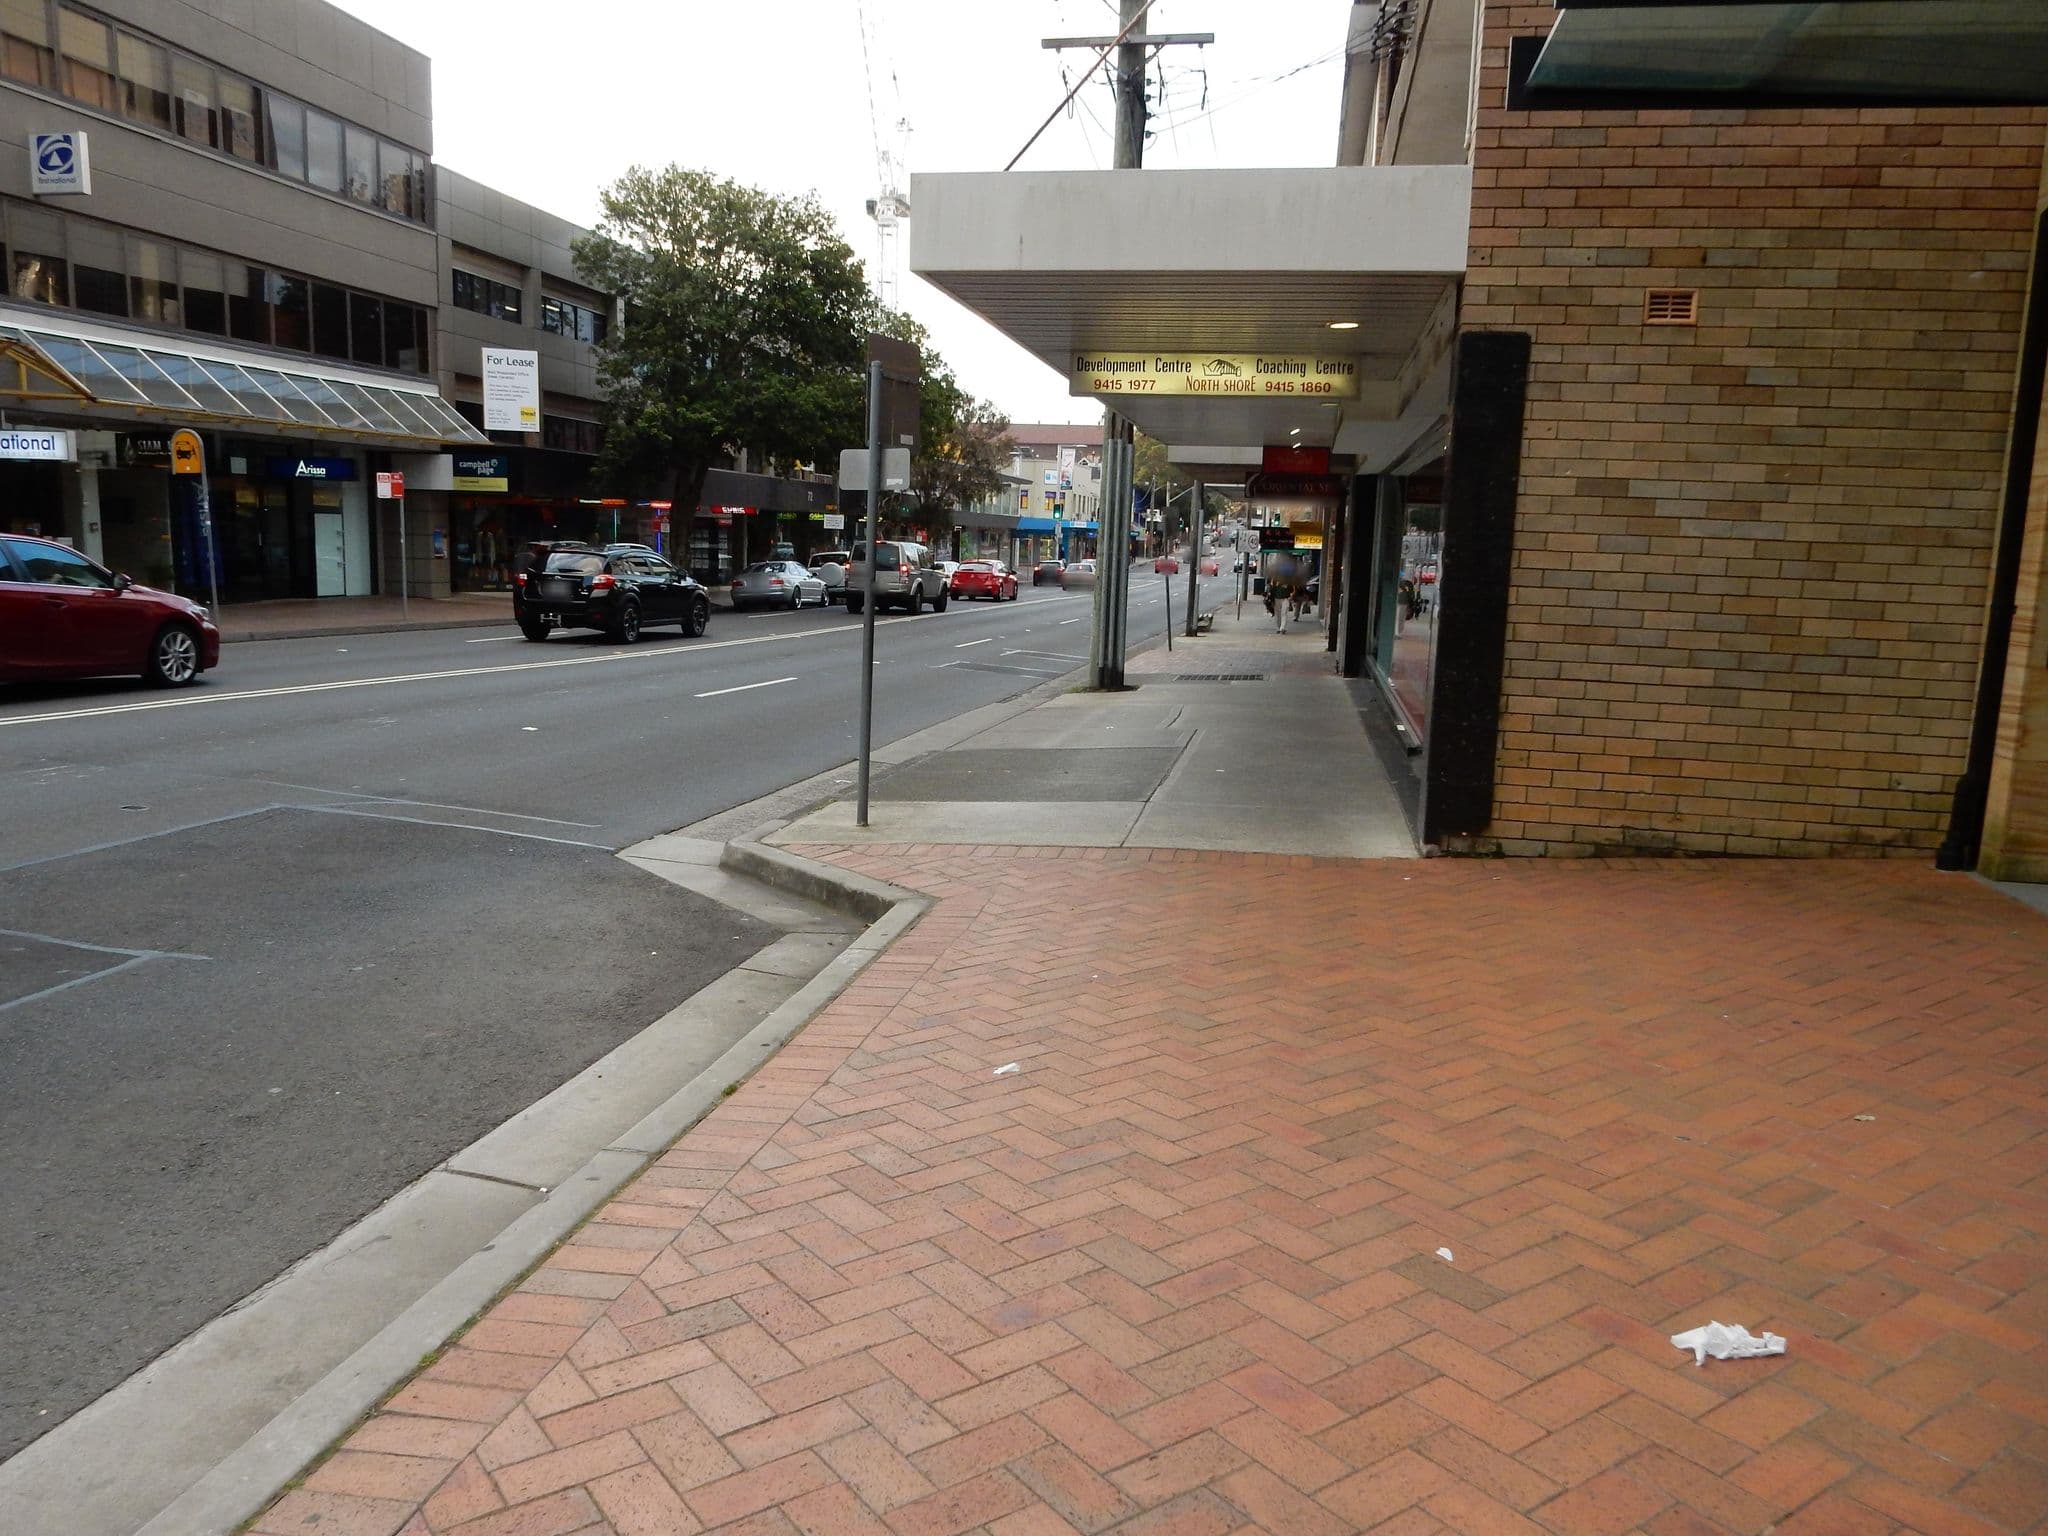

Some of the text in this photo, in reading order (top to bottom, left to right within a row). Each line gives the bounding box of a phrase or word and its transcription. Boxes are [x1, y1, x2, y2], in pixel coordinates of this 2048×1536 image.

[487, 355, 535, 367] For Lease
[1076, 356, 1192, 376] Development Centre
[1256, 358, 1354, 377] Coaching Centre
[1093, 379, 1157, 391] 9415 1977
[1185, 375, 1257, 392] NORTH SHORE
[1265, 381, 1331, 393] 9415 1860
[295, 460, 326, 477] Arissa
[459, 459, 490, 469] campbell
[477, 466, 495, 476] page
